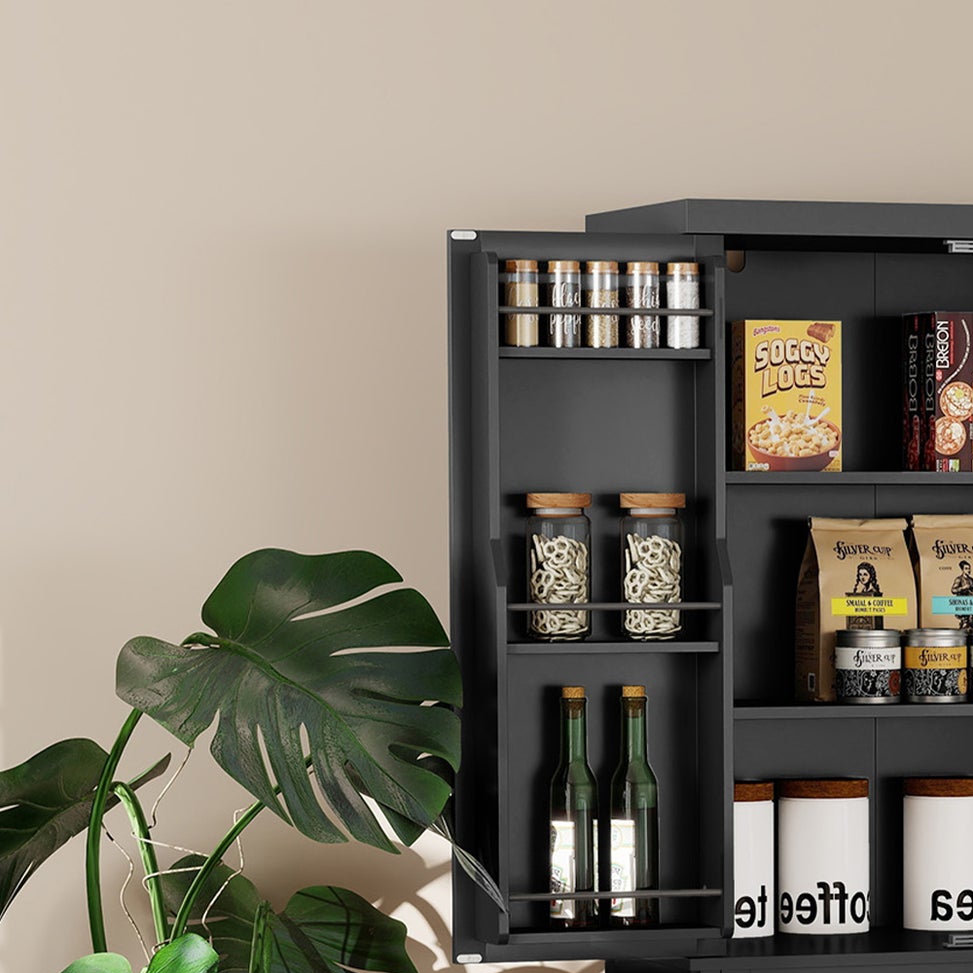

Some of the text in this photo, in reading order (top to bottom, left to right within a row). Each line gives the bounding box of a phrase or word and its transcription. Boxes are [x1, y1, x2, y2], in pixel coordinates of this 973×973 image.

[754, 338, 830, 372] SOGGY
[762, 364, 826, 398] LOGS
[832, 540, 874, 560] SILVER
[932, 540, 972, 559] SILVER
[853, 649, 882, 667] SILVER
[918, 649, 948, 667] SILVER
